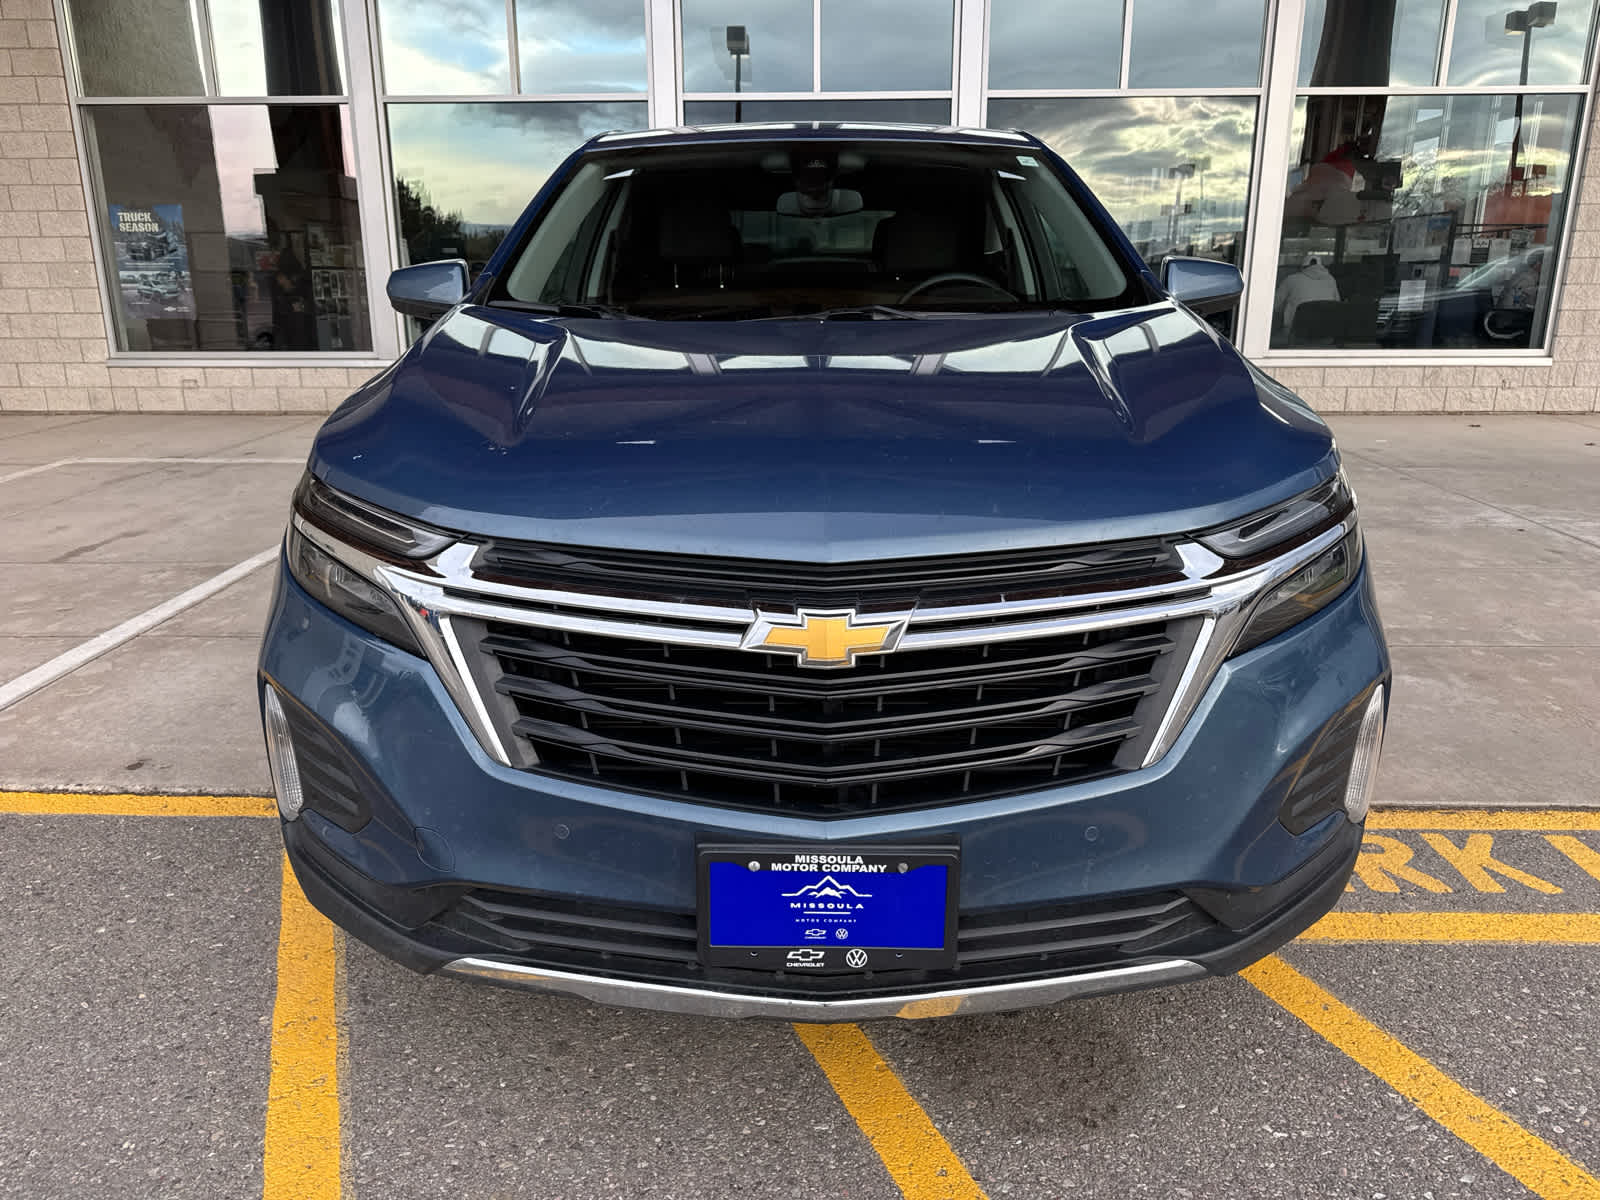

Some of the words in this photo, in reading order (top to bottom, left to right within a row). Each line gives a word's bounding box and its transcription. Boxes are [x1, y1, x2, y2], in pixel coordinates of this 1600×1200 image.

[117, 212, 152, 222] TRUCK
[119, 222, 159, 233] SEASON
[794, 854, 864, 864] MISSOULA
[1345, 833, 1600, 894] RK
[771, 863, 819, 872] MOTOR
[822, 863, 887, 873] COMPANY
